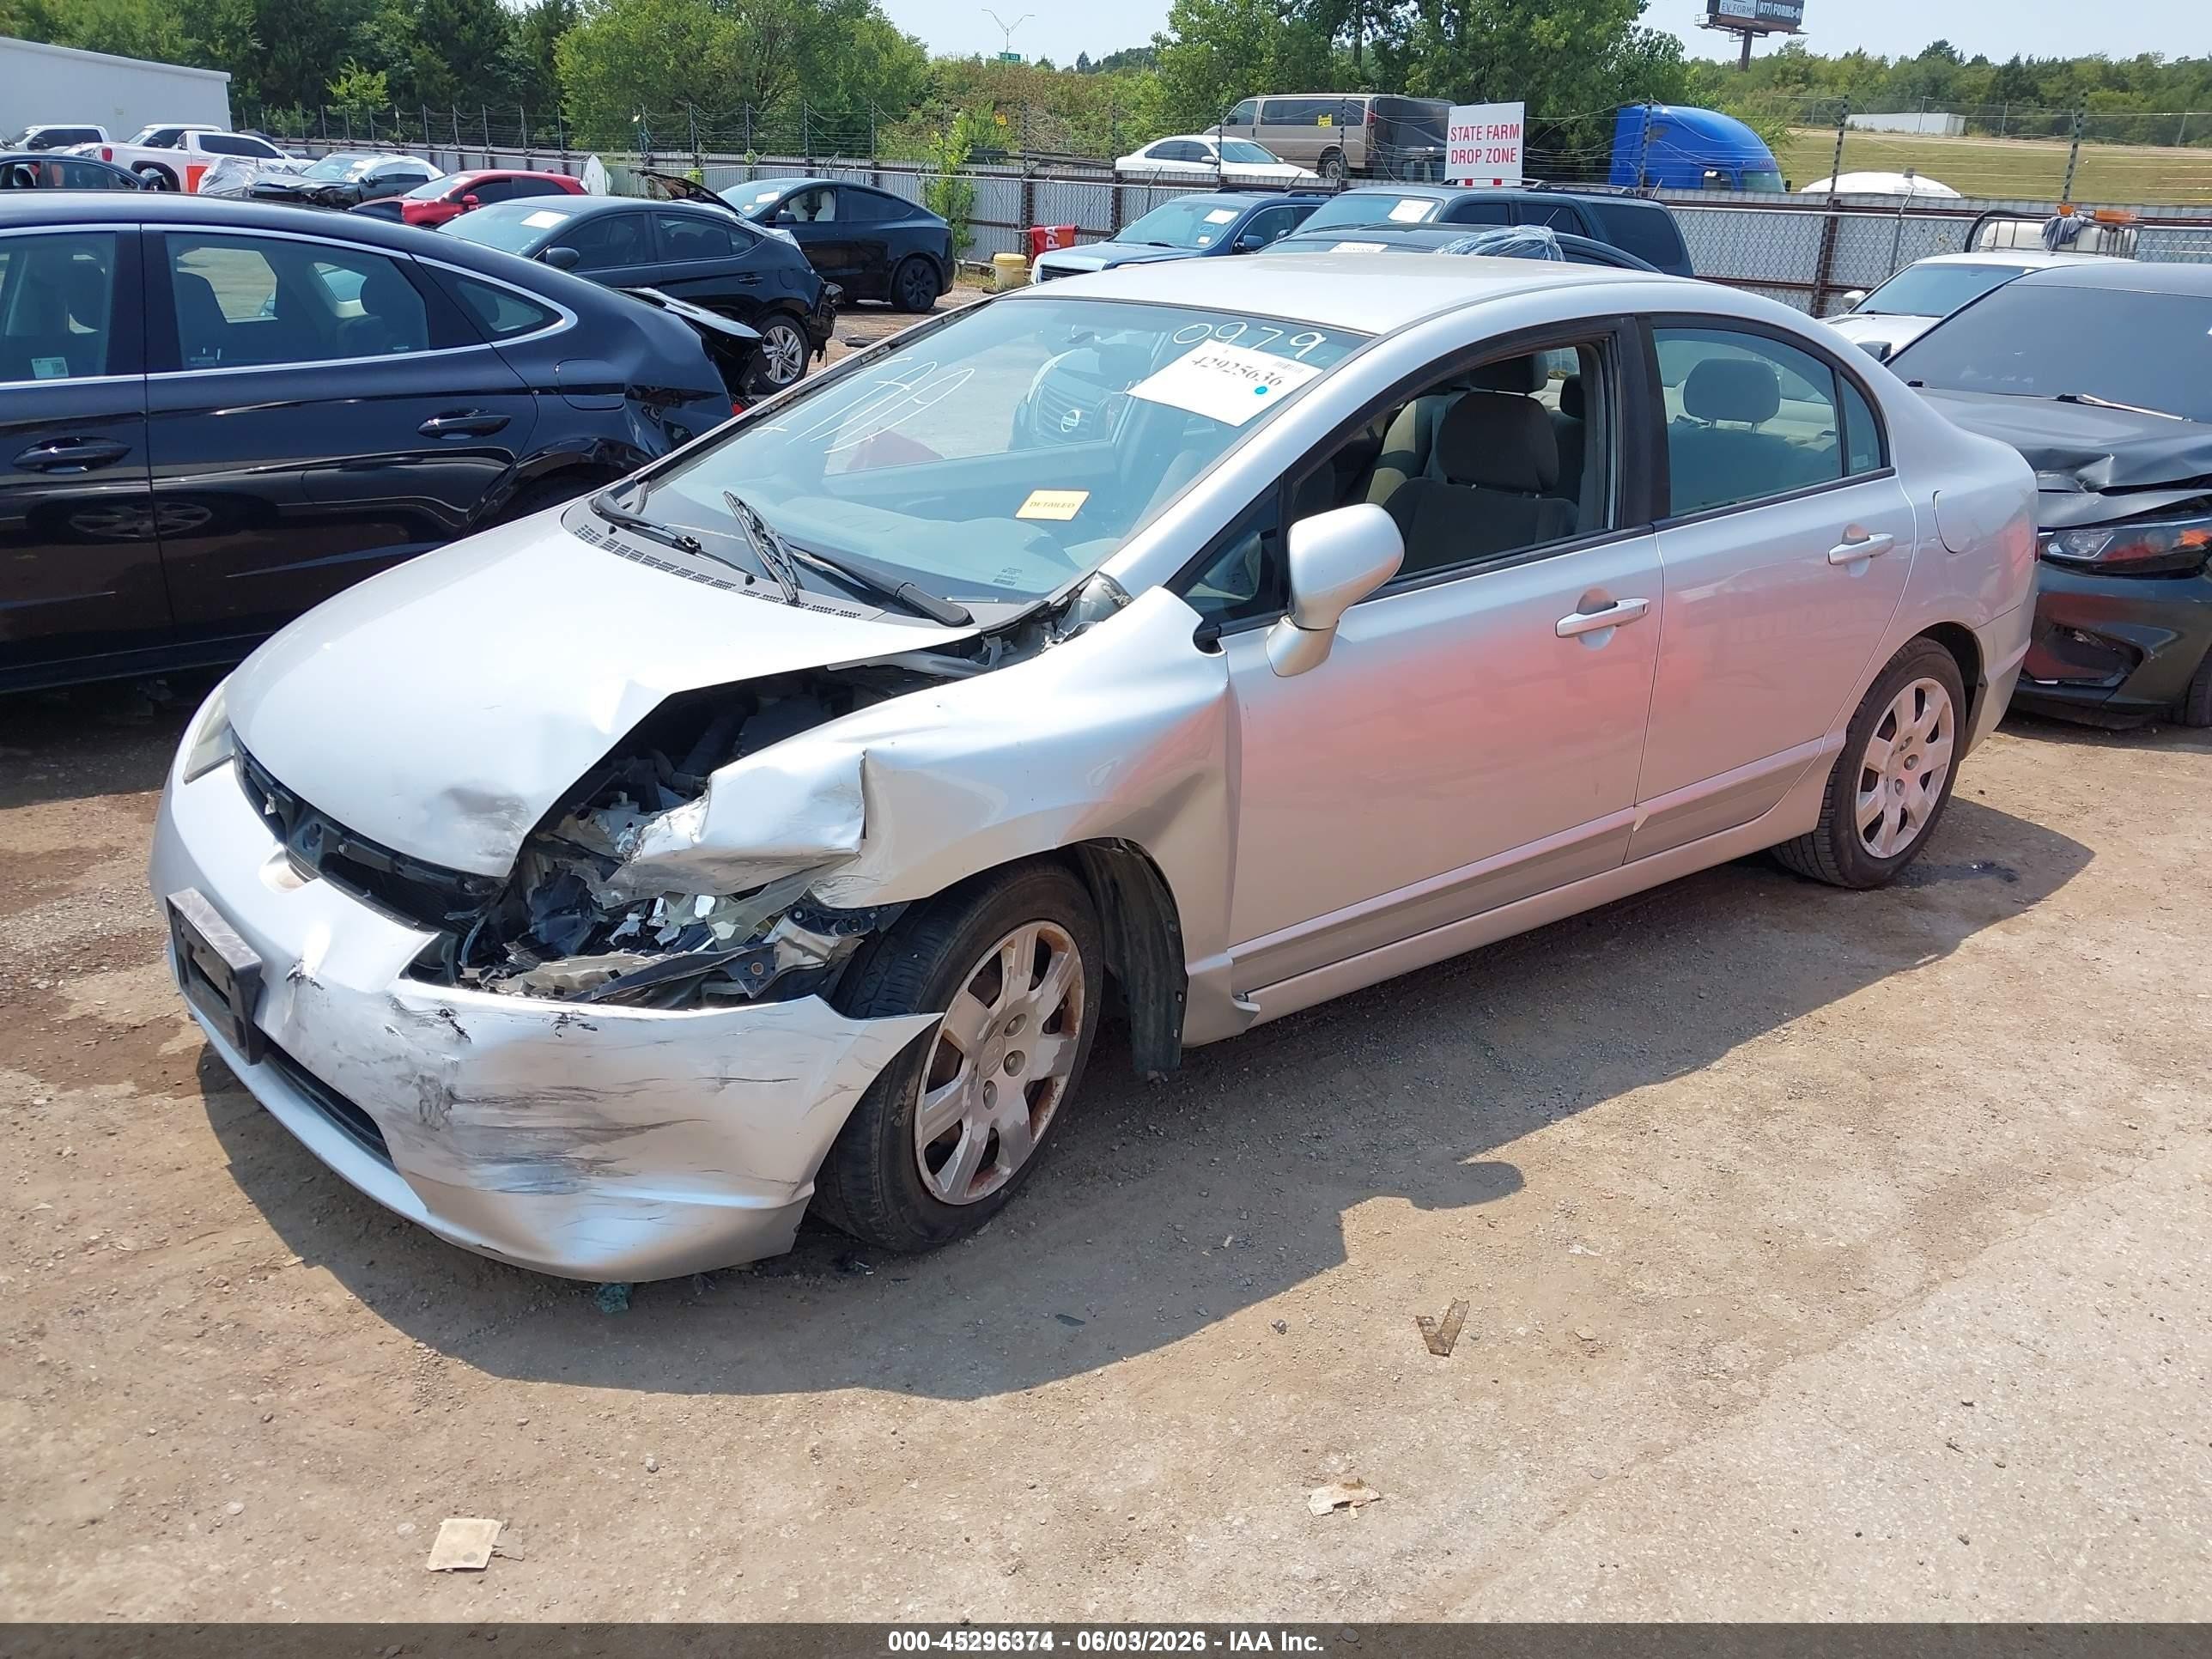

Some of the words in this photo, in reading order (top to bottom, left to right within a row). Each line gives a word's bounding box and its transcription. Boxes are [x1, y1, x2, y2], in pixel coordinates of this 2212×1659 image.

[1734, 3, 1755, 15] FORMS
[1450, 125, 1483, 142] STATE
[1486, 123, 1520, 140] FARM
[1450, 148, 1482, 164] DROP
[1486, 147, 1517, 164] ZONE
[1173, 322, 1328, 360] 0979
[1192, 356, 1283, 386] 42925636
[1029, 501, 1076, 509] DETAILED
